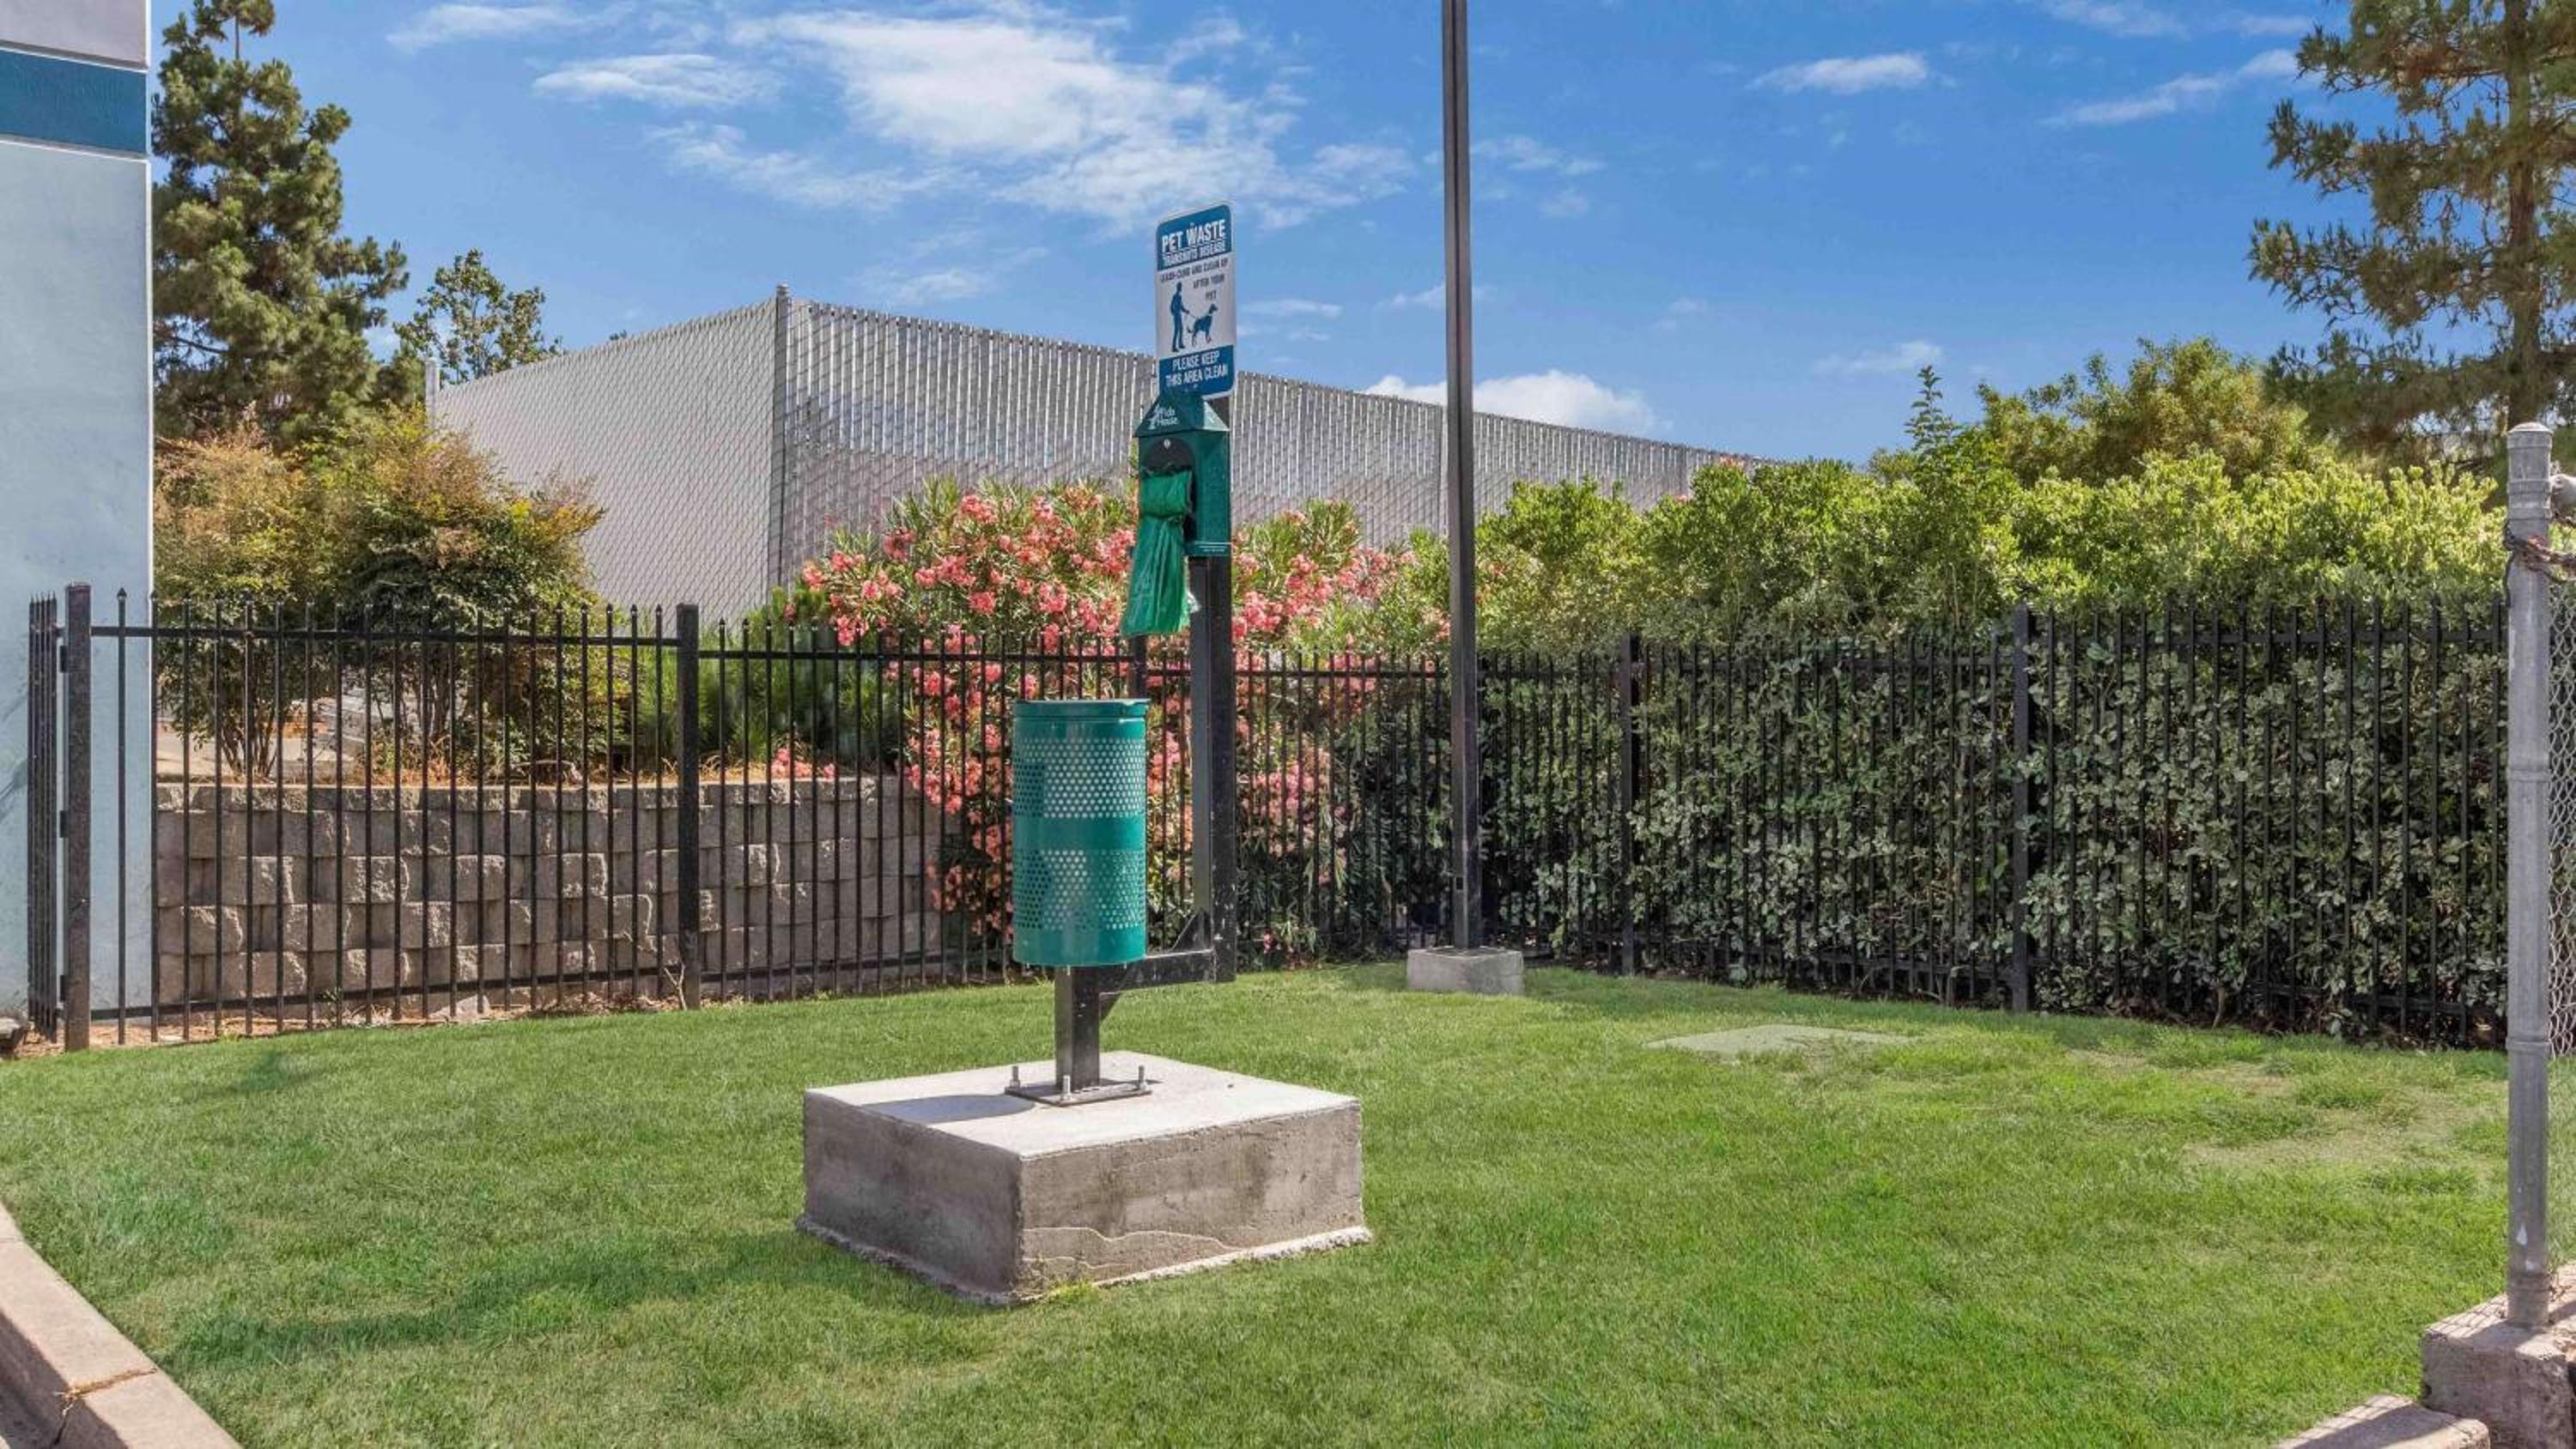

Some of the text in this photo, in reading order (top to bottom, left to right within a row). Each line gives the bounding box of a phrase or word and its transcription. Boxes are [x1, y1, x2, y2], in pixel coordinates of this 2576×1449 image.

[1162, 220, 1226, 253] PET WASTE
[1172, 350, 1220, 372] PLEASE KEEP
[1165, 363, 1229, 387] THIS AREA CLEAN
